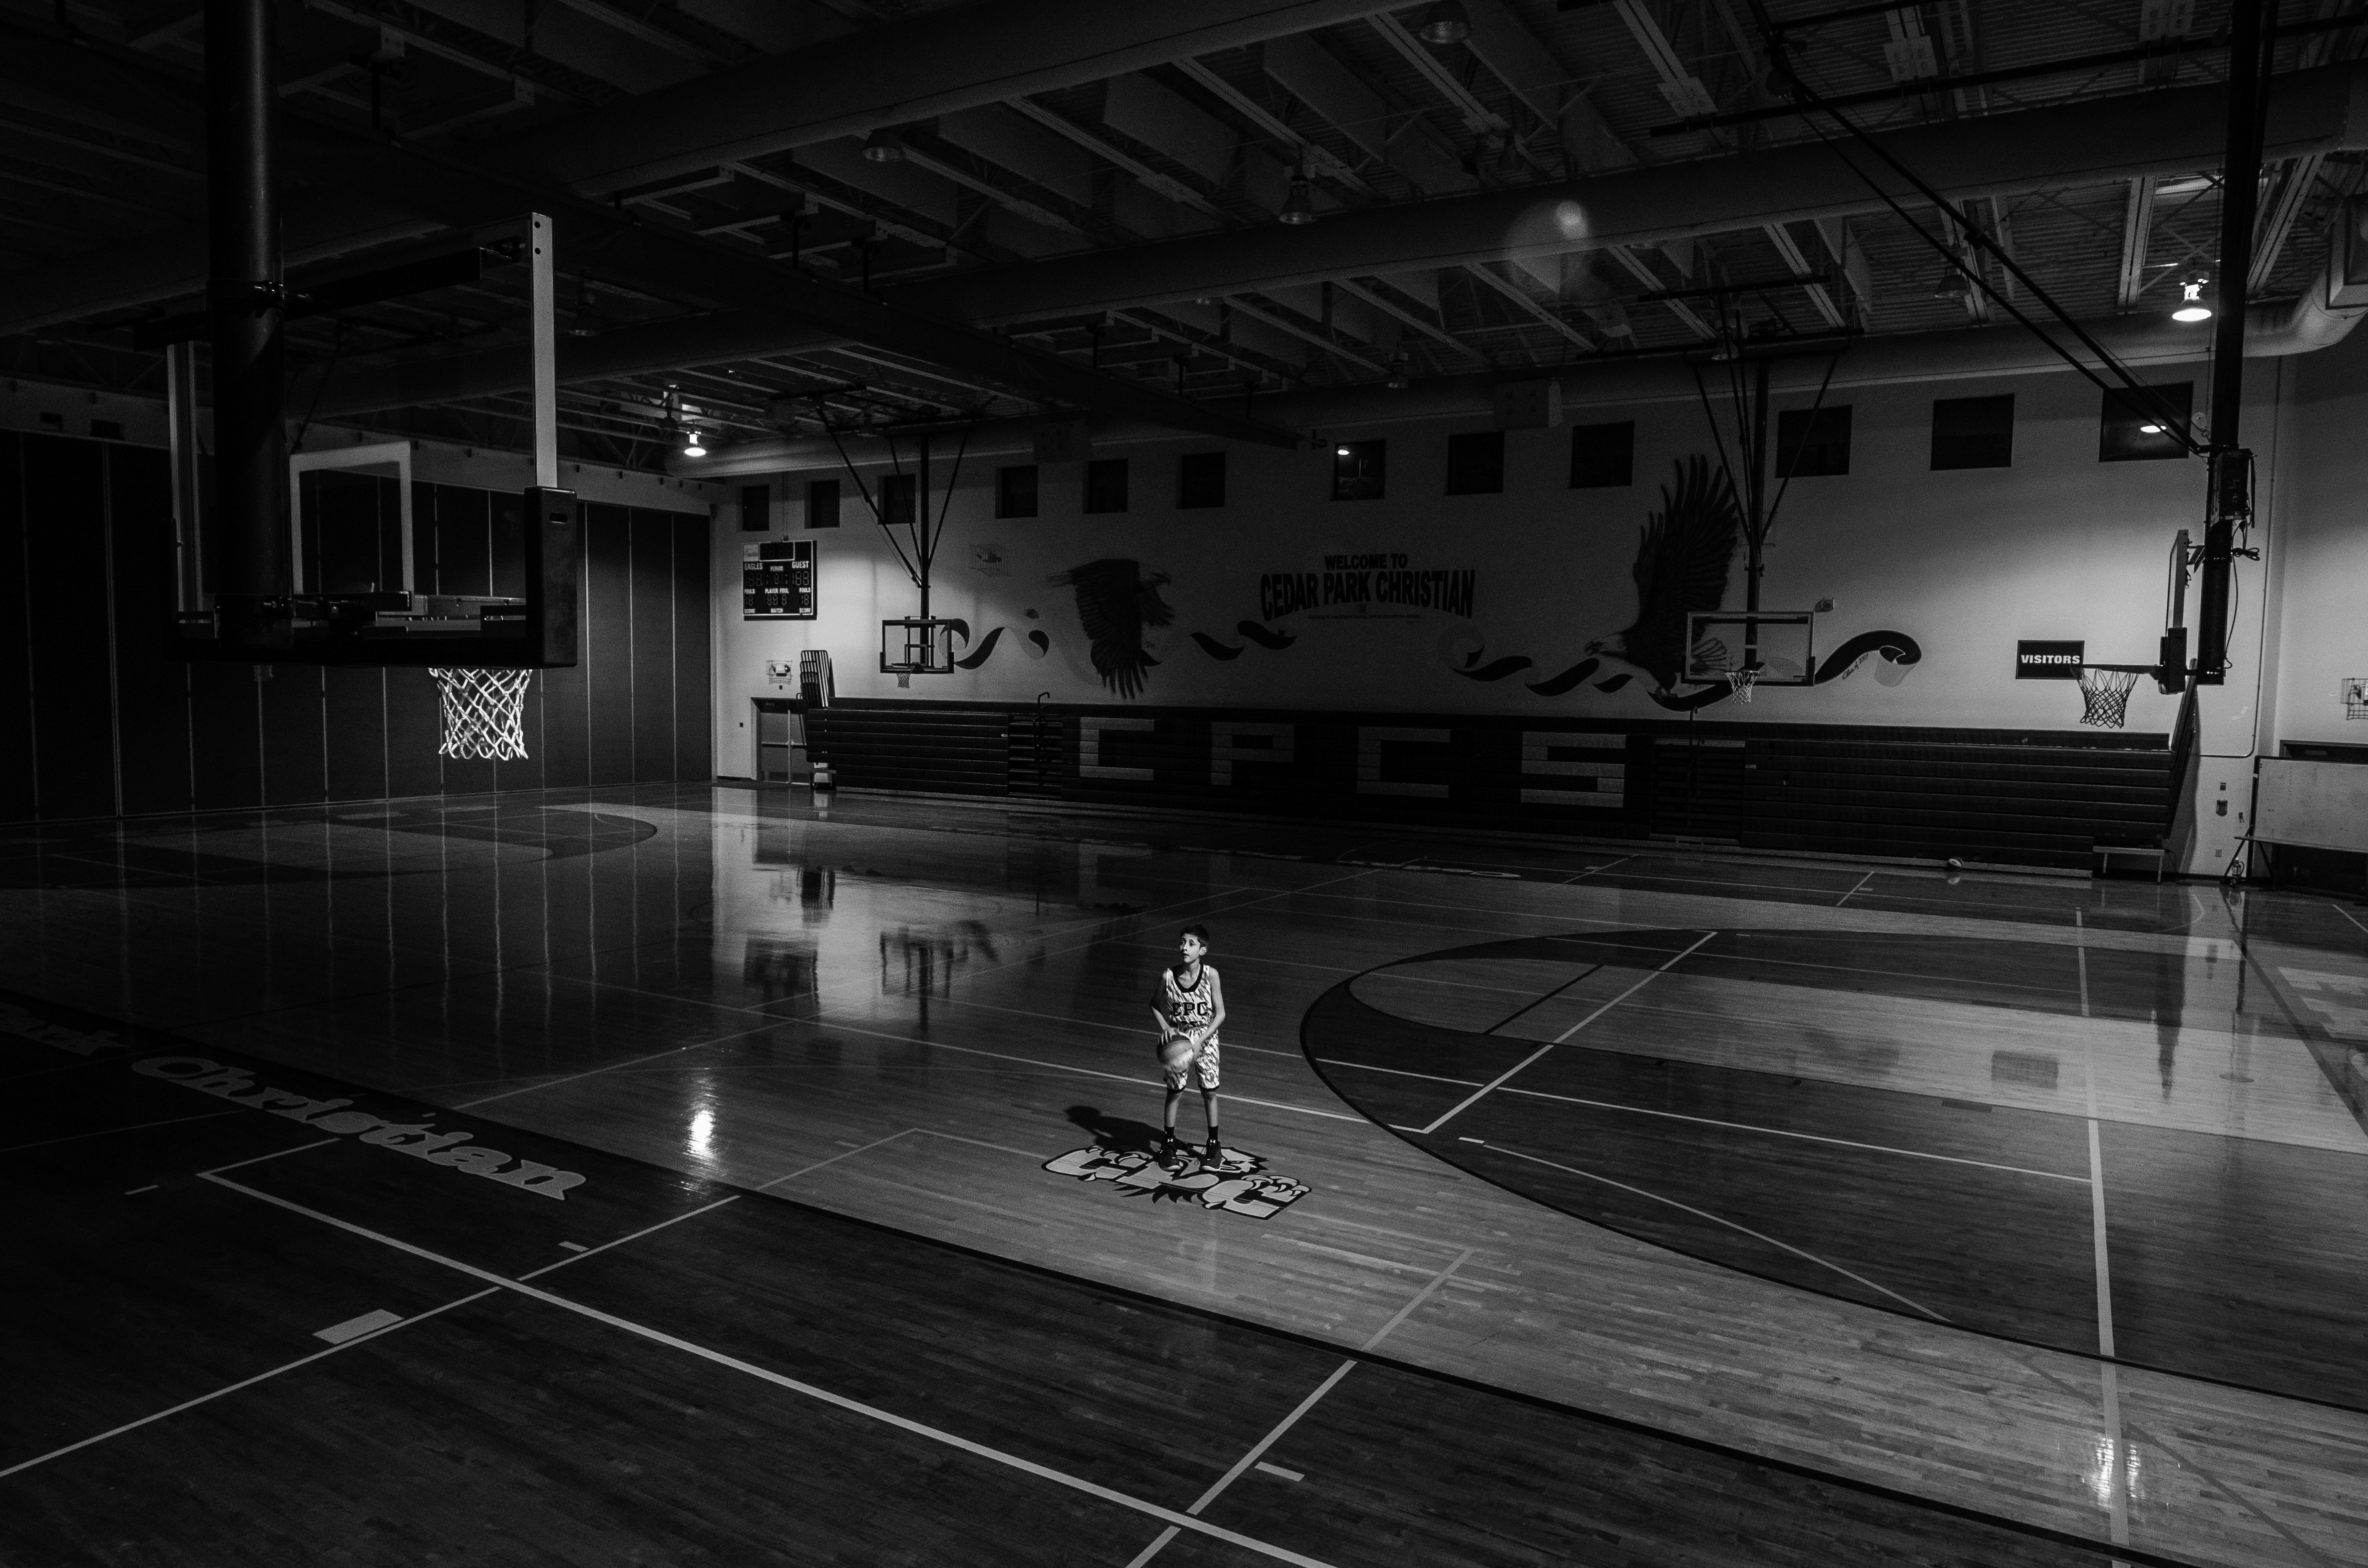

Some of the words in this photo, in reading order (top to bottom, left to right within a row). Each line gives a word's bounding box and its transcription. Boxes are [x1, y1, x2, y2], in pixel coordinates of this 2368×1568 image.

[1325, 554, 1387, 570] WELCOME
[1391, 553, 1408, 569] TO
[1260, 573, 1319, 622] CEDAR
[1324, 571, 1371, 606] PARK
[1375, 569, 1475, 619] CHRISTIAN
[2021, 655, 2081, 664] VISITORS
[1172, 1001, 1208, 1016] CPC
[131, 1056, 587, 1201] Christian
